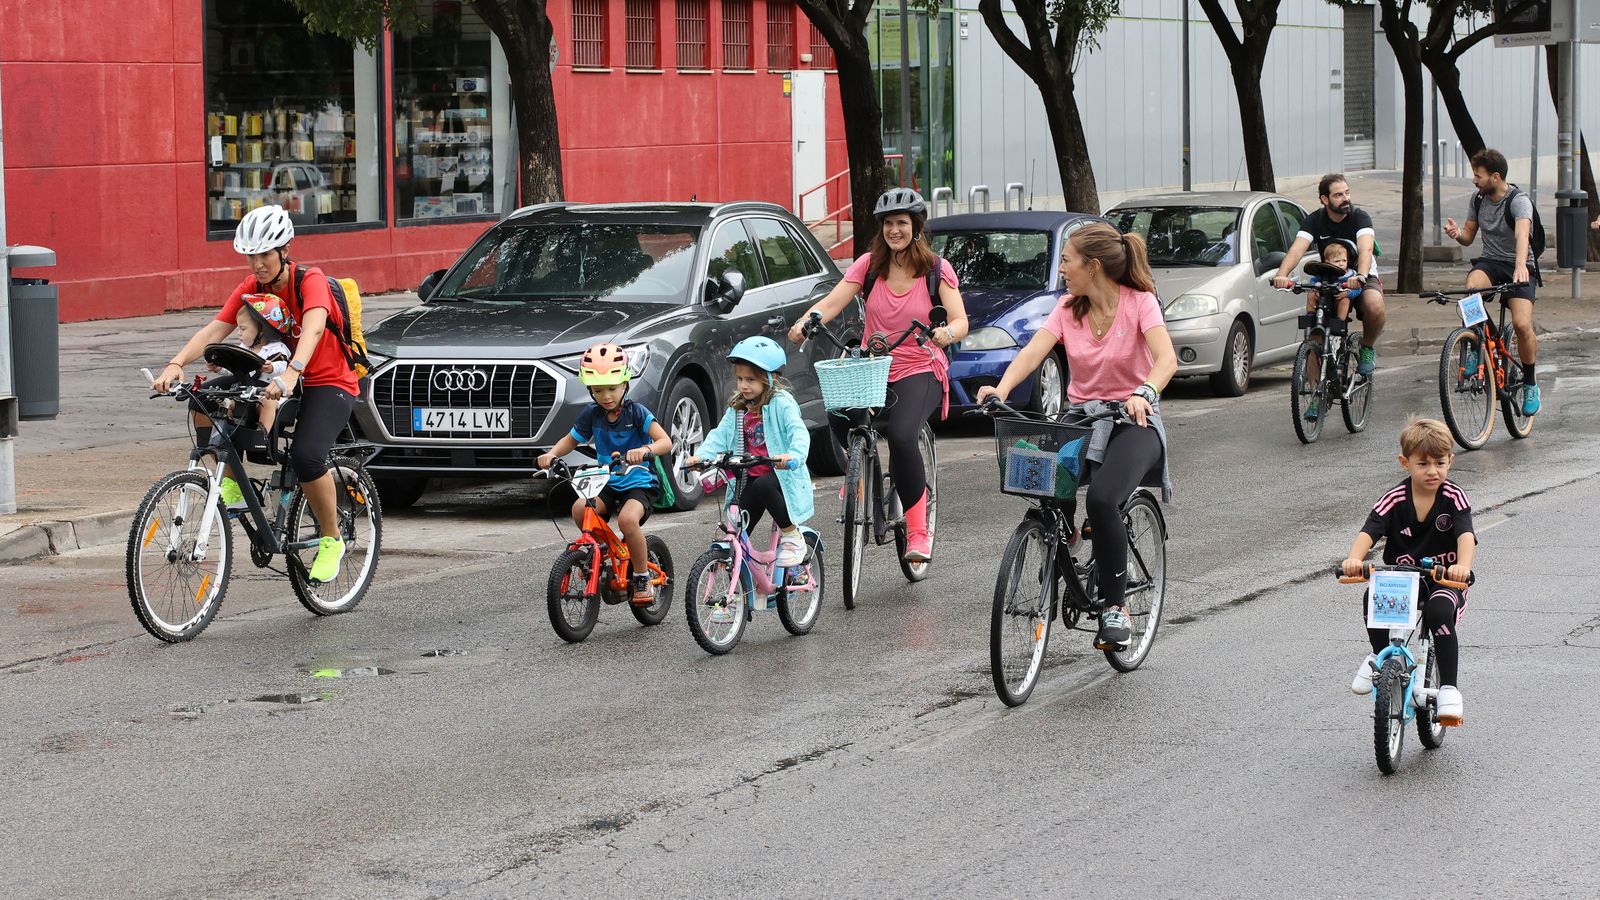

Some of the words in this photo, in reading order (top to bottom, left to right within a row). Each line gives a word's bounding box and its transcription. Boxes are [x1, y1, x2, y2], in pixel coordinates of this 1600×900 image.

[426, 412, 466, 428] 4714
[473, 412, 505, 428] LVK
[577, 477, 591, 491] 6
